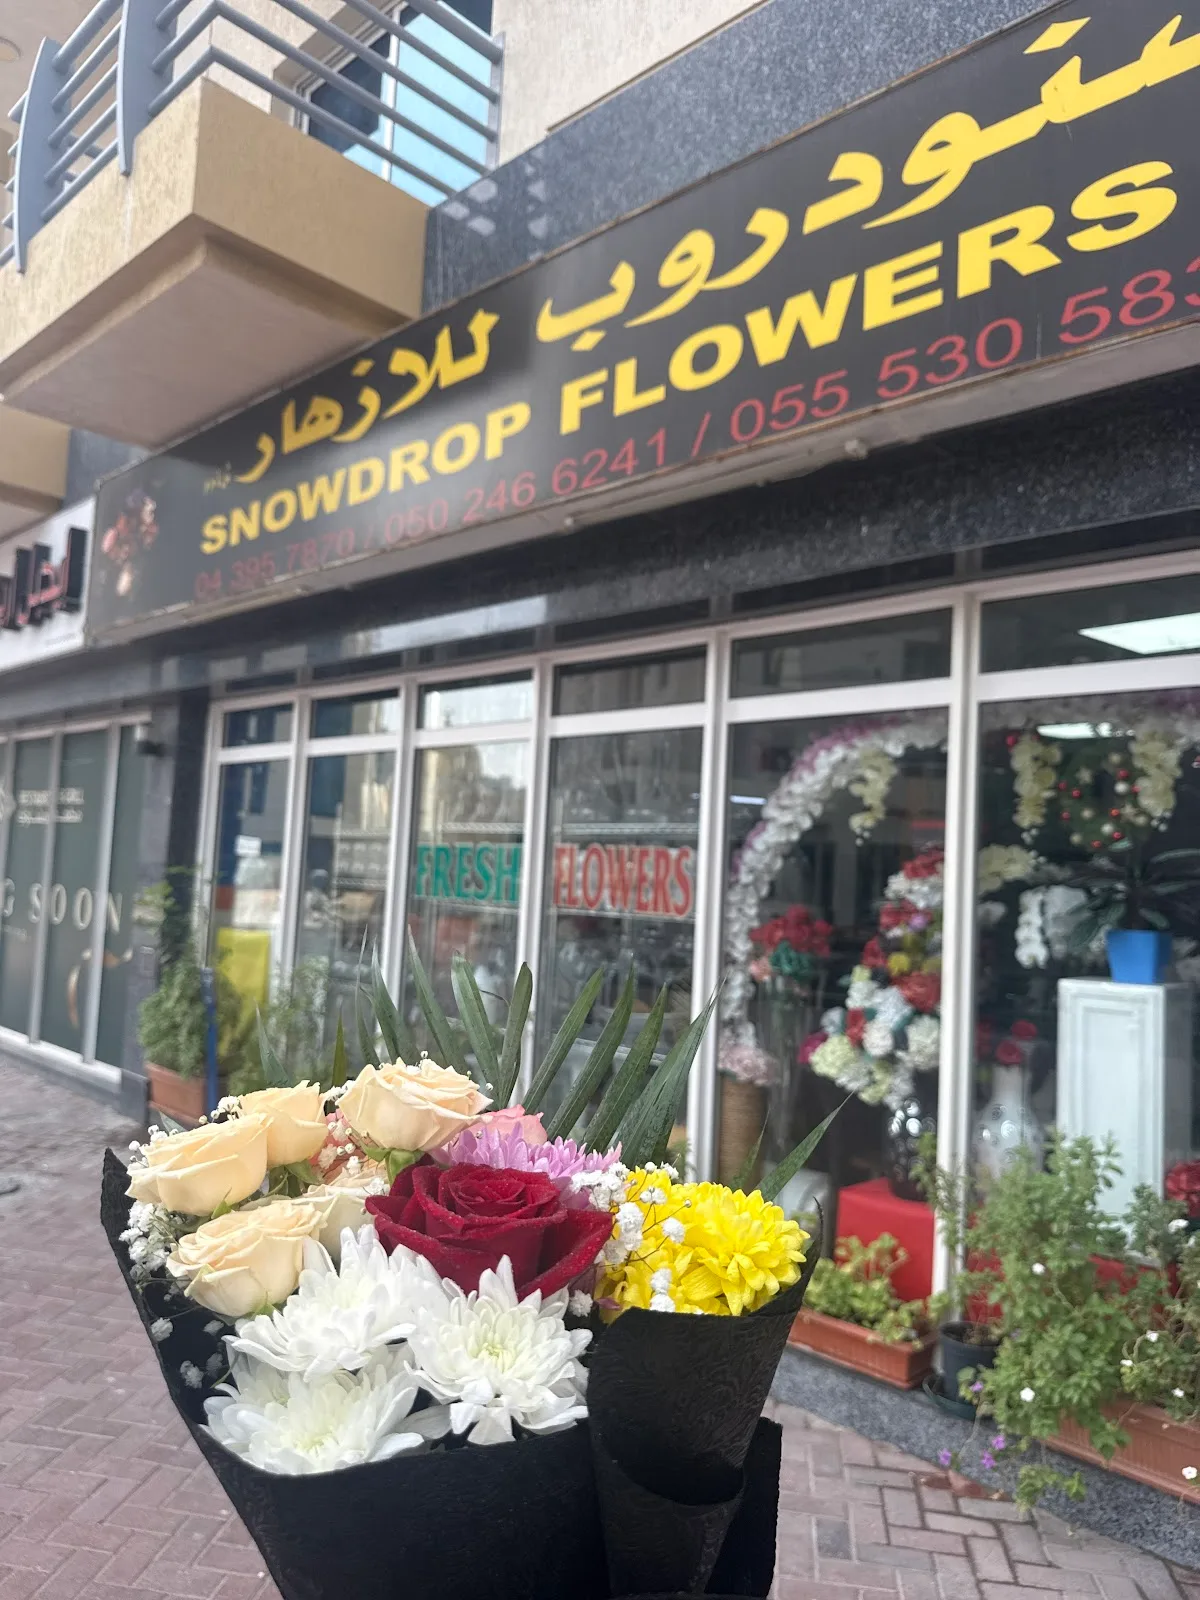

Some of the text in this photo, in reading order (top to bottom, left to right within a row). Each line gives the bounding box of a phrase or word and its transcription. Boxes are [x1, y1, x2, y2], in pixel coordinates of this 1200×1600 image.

[200, 160, 1178, 556] SNOWDROP FLOWERS
[463, 471, 536, 524] 246
[552, 428, 667, 495] 6241
[729, 369, 849, 442] 055
[876, 317, 1023, 399] 530
[28, 882, 122, 935] SOON
[415, 841, 693, 917] FRESH FLOWERS
